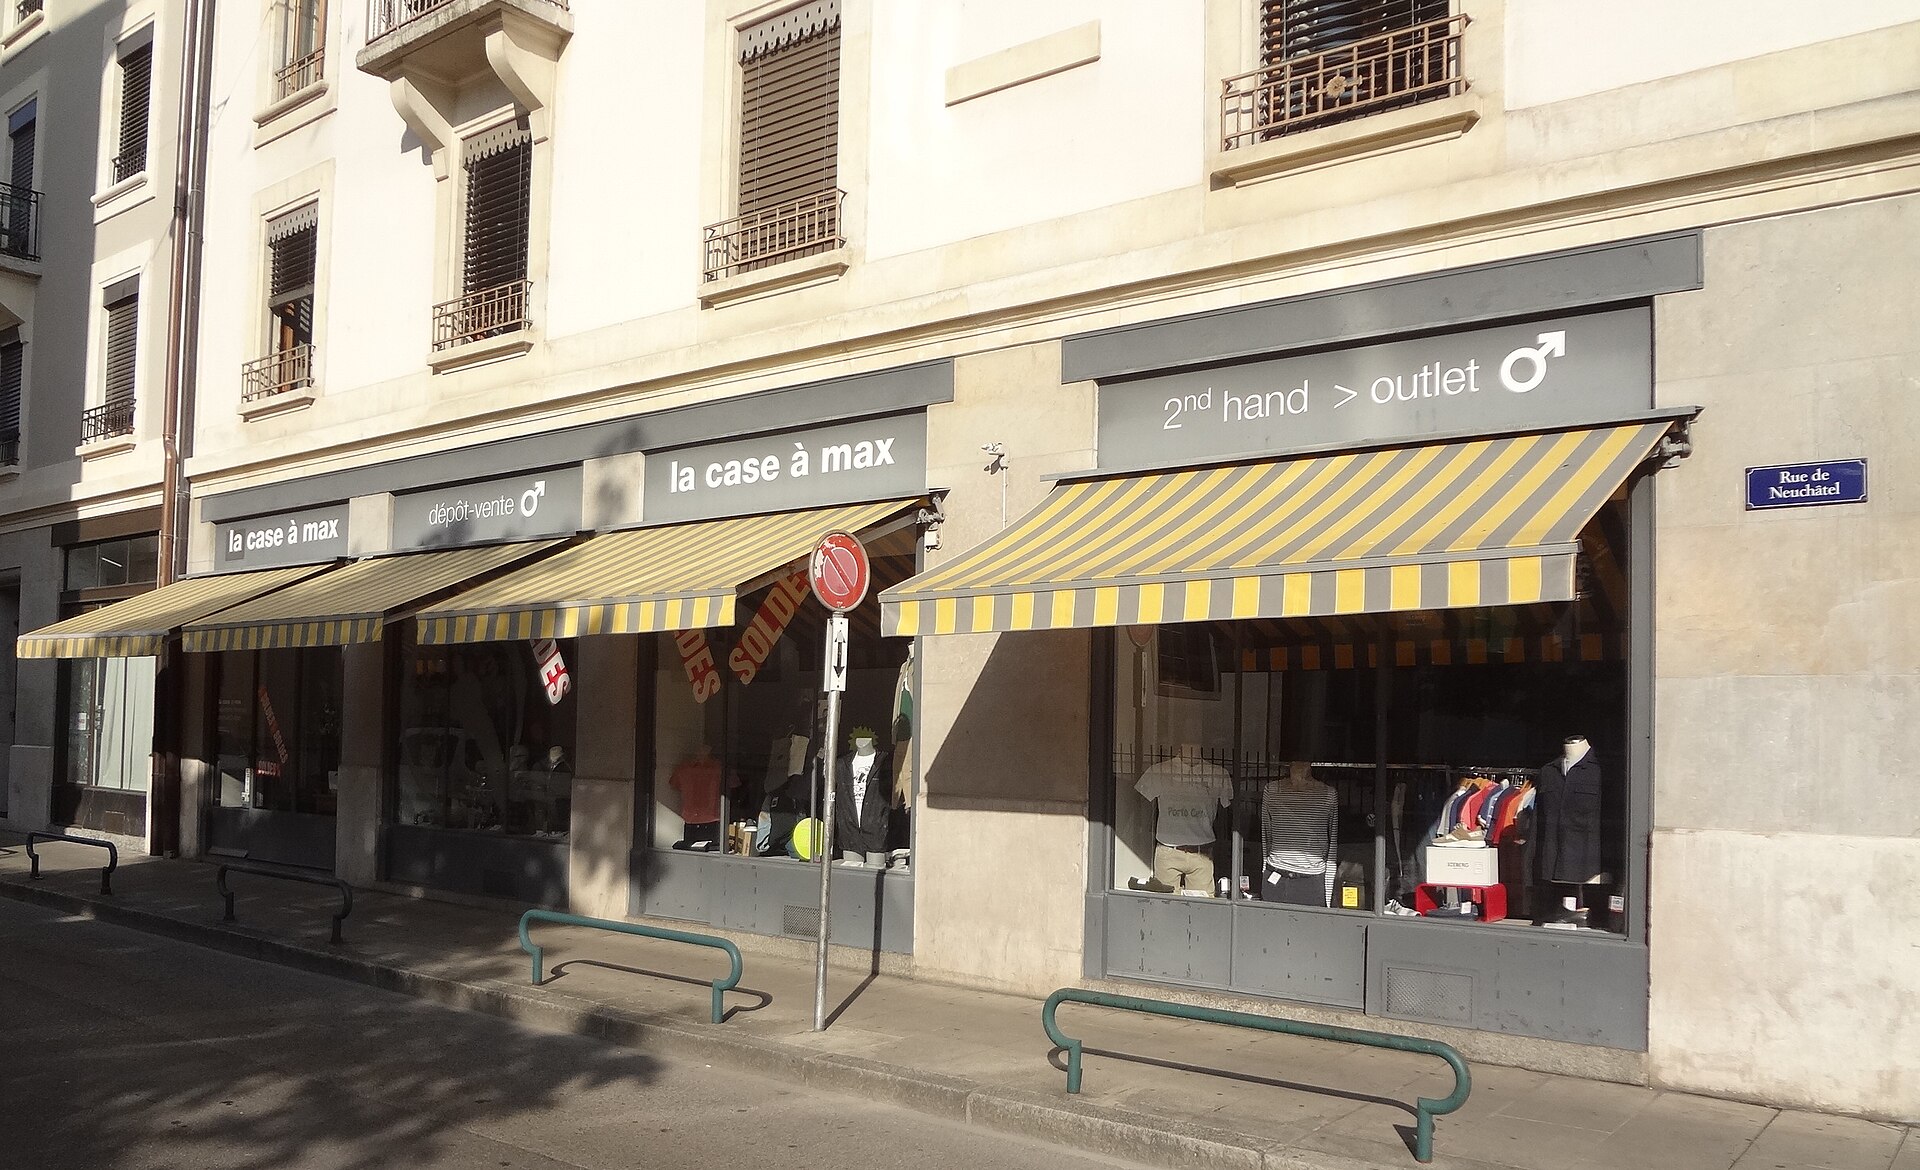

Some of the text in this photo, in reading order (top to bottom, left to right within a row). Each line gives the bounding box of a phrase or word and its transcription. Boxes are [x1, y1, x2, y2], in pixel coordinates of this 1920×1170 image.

[1163, 387, 1212, 430] 2nd
[1222, 380, 1310, 422] hand
[1370, 358, 1480, 404] outlet
[670, 437, 896, 493] la case à max
[1780, 468, 1830, 483] Rue de
[1769, 482, 1840, 499] Neuchâtel
[429, 495, 515, 528] dépôt-vente
[228, 518, 339, 553] la case à max
[728, 573, 812, 686] SOLDE
